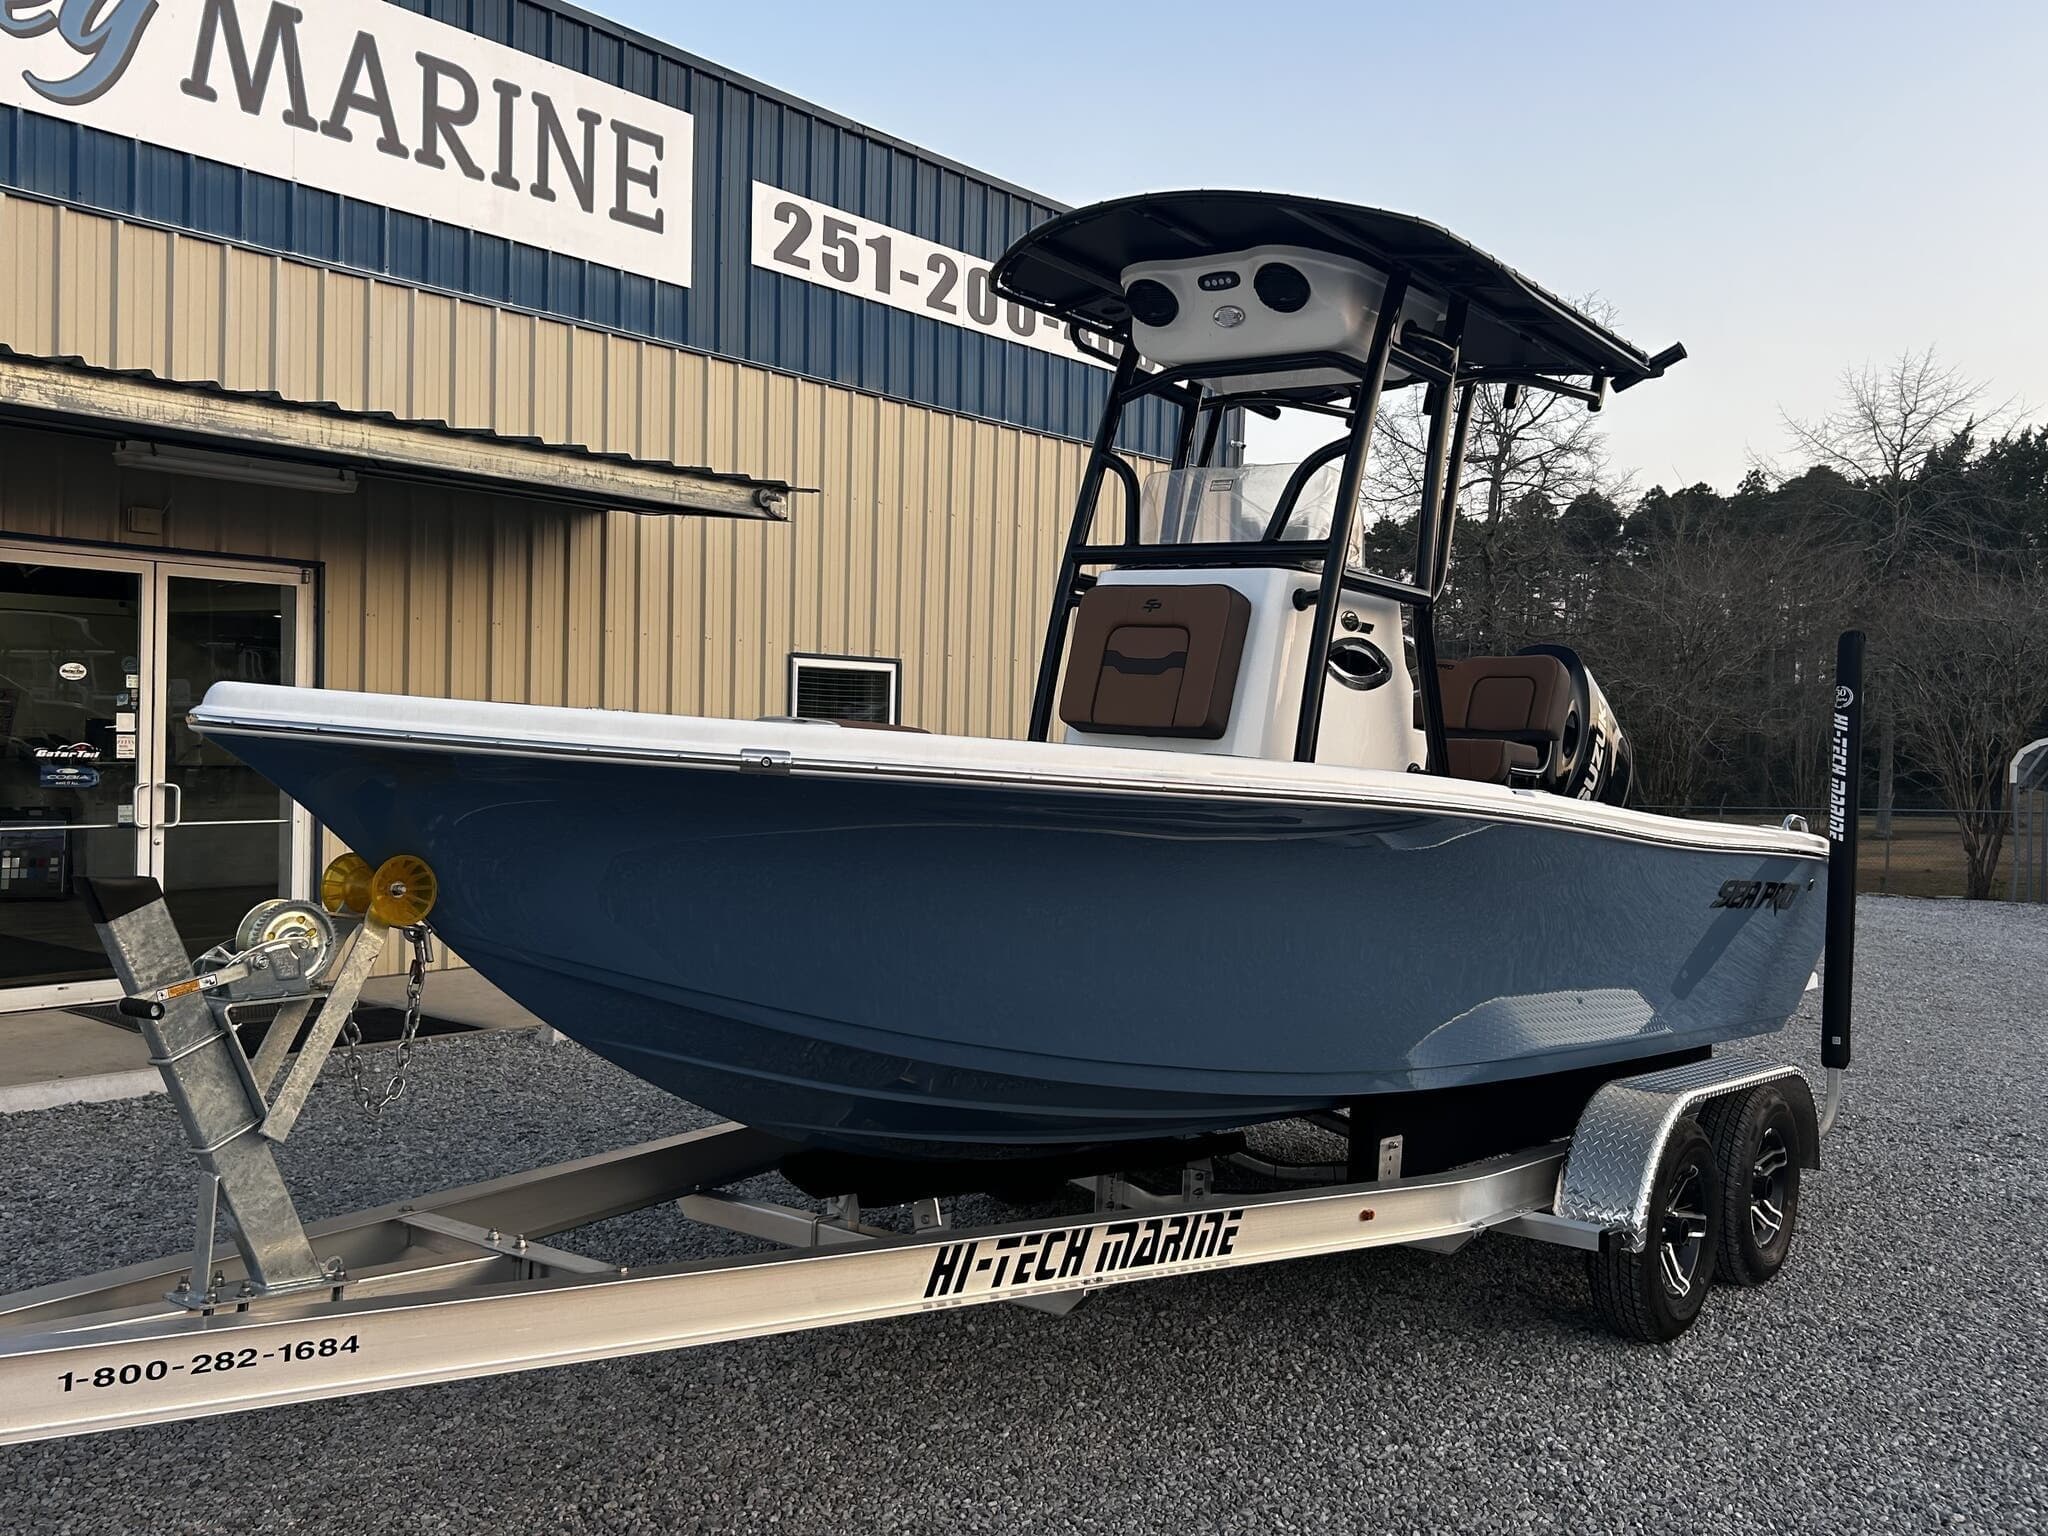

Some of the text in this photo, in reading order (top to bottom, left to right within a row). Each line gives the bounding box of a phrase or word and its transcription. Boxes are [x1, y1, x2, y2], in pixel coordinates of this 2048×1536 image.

[180, 0, 664, 234] MARINE
[773, 201, 1156, 372] 251-200-
[36, 749, 101, 758] GatorTail
[1831, 712, 1849, 776] HI-TECH
[1829, 777, 1847, 842] MARINE
[924, 1210, 1244, 1298] HI-TECH MARINE
[58, 1335, 360, 1392] 1-800-282-1684
